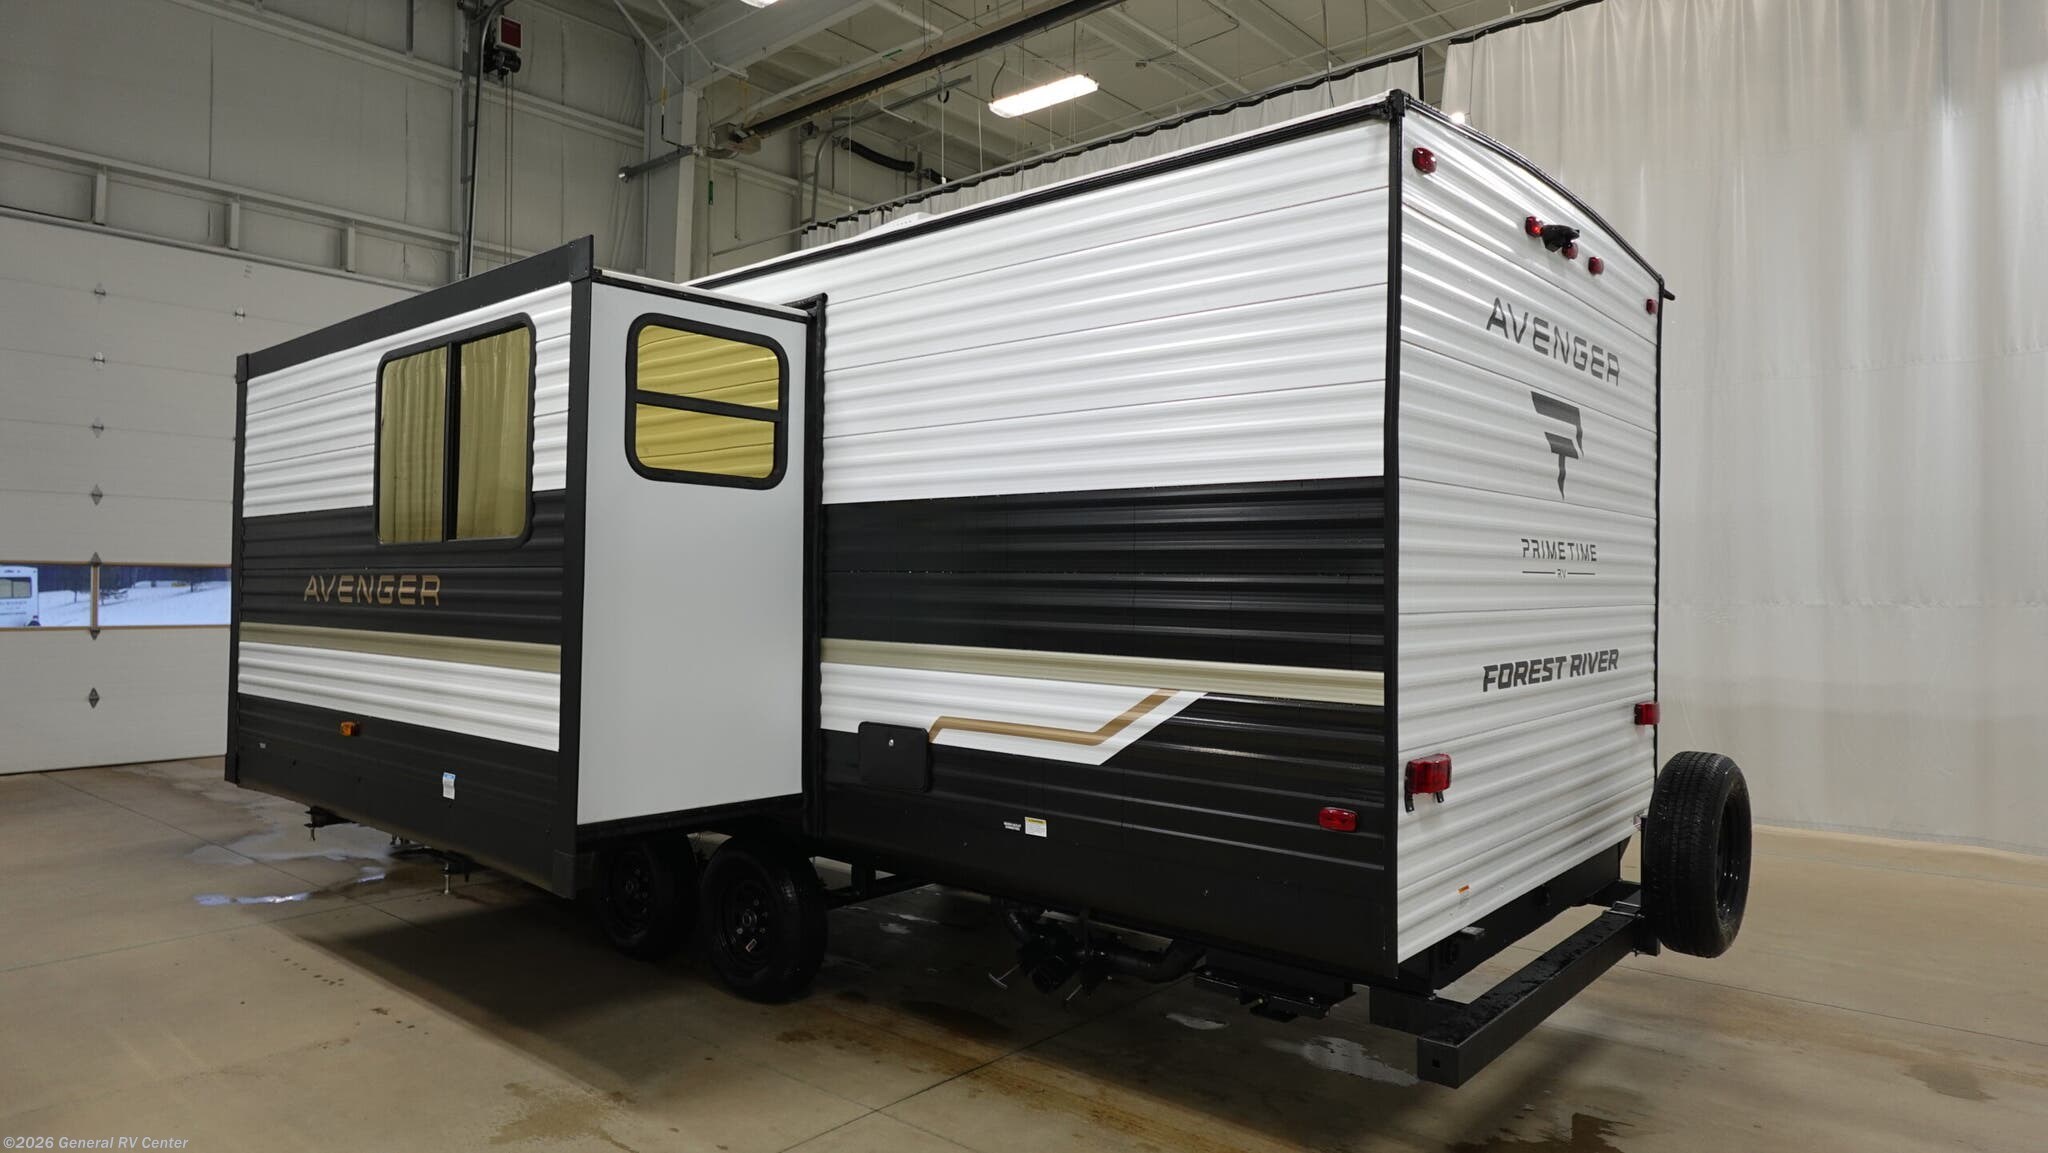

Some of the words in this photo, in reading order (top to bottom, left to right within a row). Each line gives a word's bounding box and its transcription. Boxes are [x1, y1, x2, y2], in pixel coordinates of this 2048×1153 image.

[1486, 297, 1620, 386] AVENGER
[1520, 538, 1597, 562] PRIMETIME
[304, 574, 441, 606] AVENGER
[1482, 655, 1567, 692] FOREST
[1569, 648, 1619, 678] RIVER
